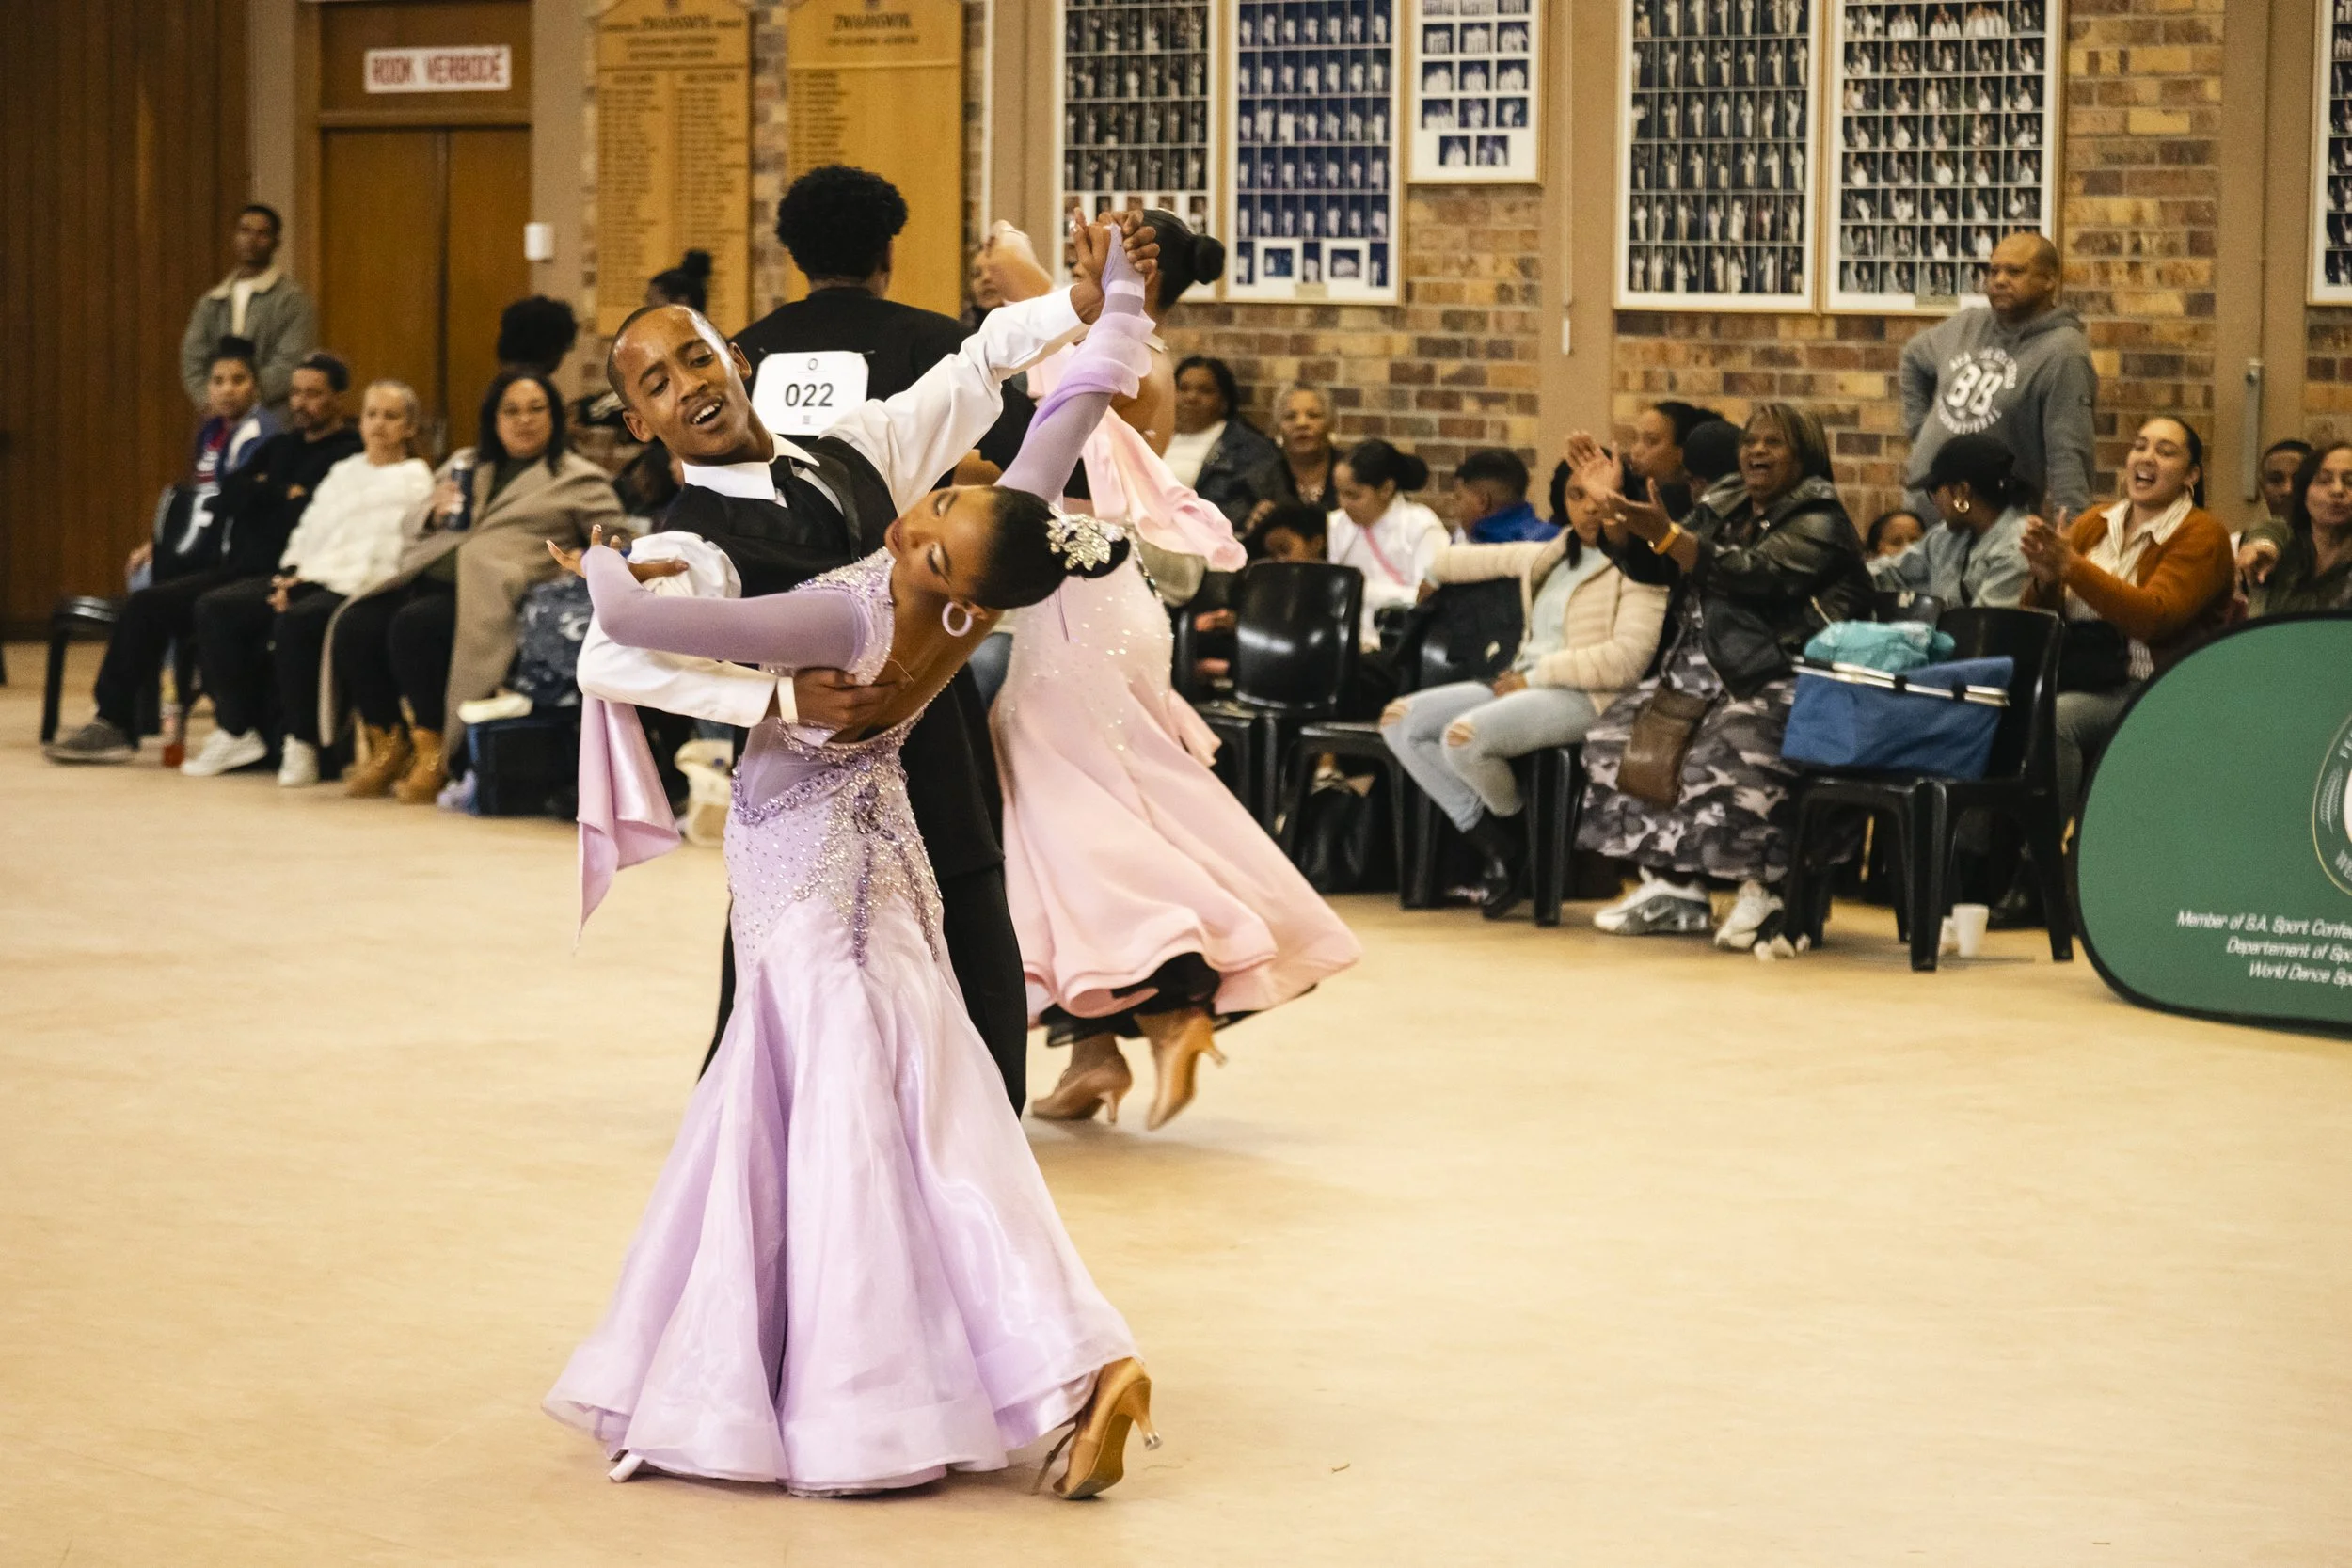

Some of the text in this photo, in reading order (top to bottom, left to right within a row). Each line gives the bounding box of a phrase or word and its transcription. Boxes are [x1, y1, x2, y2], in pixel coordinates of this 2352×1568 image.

[373, 53, 501, 84] ROOK VERBODE
[785, 383, 834, 407] 022
[1946, 362, 2003, 416] 88
[2177, 909, 2228, 929] Member
[2229, 912, 2245, 930] of
[2272, 915, 2311, 937] Sport
[2312, 918, 2352, 939] Confe
[2312, 942, 2328, 959] of
[2249, 961, 2288, 980] World
[2288, 963, 2331, 983] Dance
